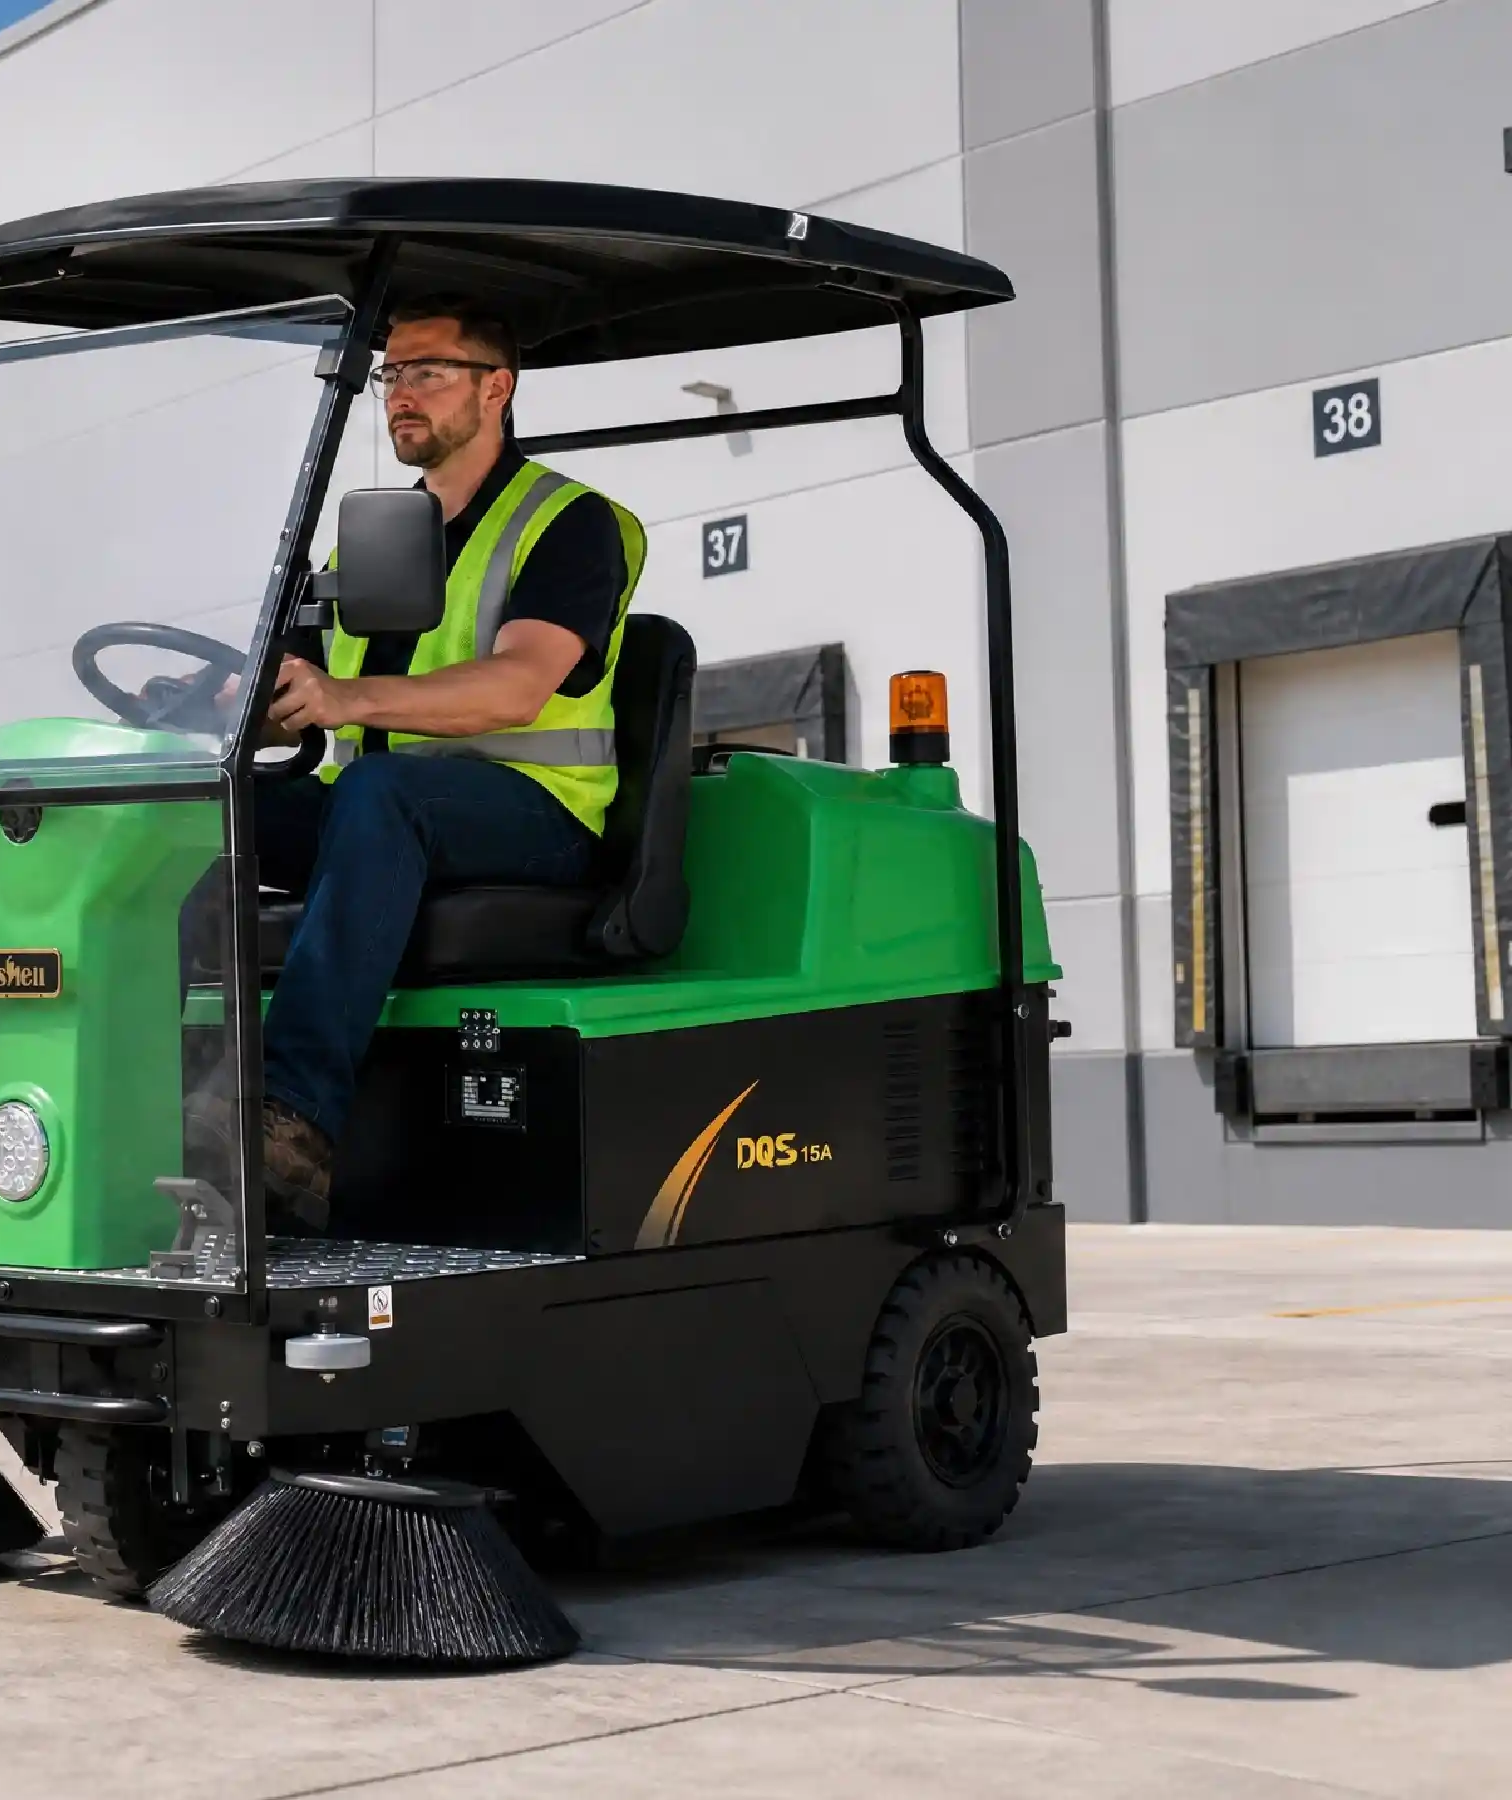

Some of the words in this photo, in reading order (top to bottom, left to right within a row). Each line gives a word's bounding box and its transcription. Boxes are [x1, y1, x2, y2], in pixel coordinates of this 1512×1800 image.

[1323, 392, 1372, 443] 38
[708, 525, 743, 567] 37
[738, 1133, 797, 1168] DQS
[801, 1144, 833, 1162] 15A
